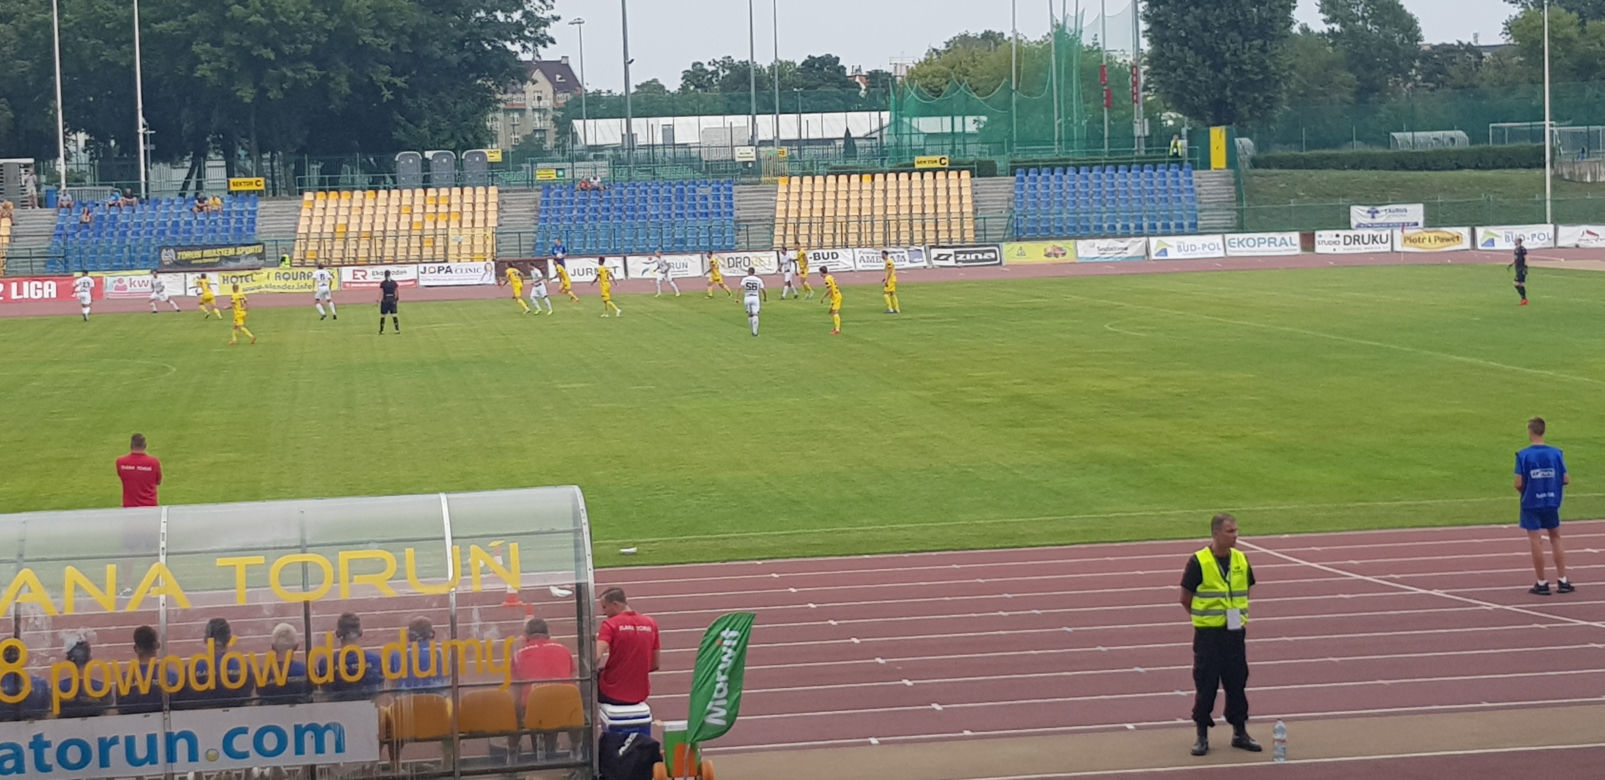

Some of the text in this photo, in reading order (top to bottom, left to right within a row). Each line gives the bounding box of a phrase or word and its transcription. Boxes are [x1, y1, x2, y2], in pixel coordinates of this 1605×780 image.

[939, 157, 947, 166] C
[1227, 237, 1297, 248] EKOPRAL
[1343, 233, 1389, 246] DRUKU
[1403, 235, 1427, 244] Piotr
[1176, 243, 1222, 252] BUD-POL
[353, 269, 368, 280] ER
[420, 265, 453, 274] JOPA
[222, 272, 257, 285] HOTEL
[11, 280, 57, 300] LIGA
[216, 540, 520, 606] TORUŃ
[51, 635, 293, 715] powodów
[308, 631, 366, 685] do
[381, 627, 515, 691] dumy
[704, 627, 740, 726] Marwit
